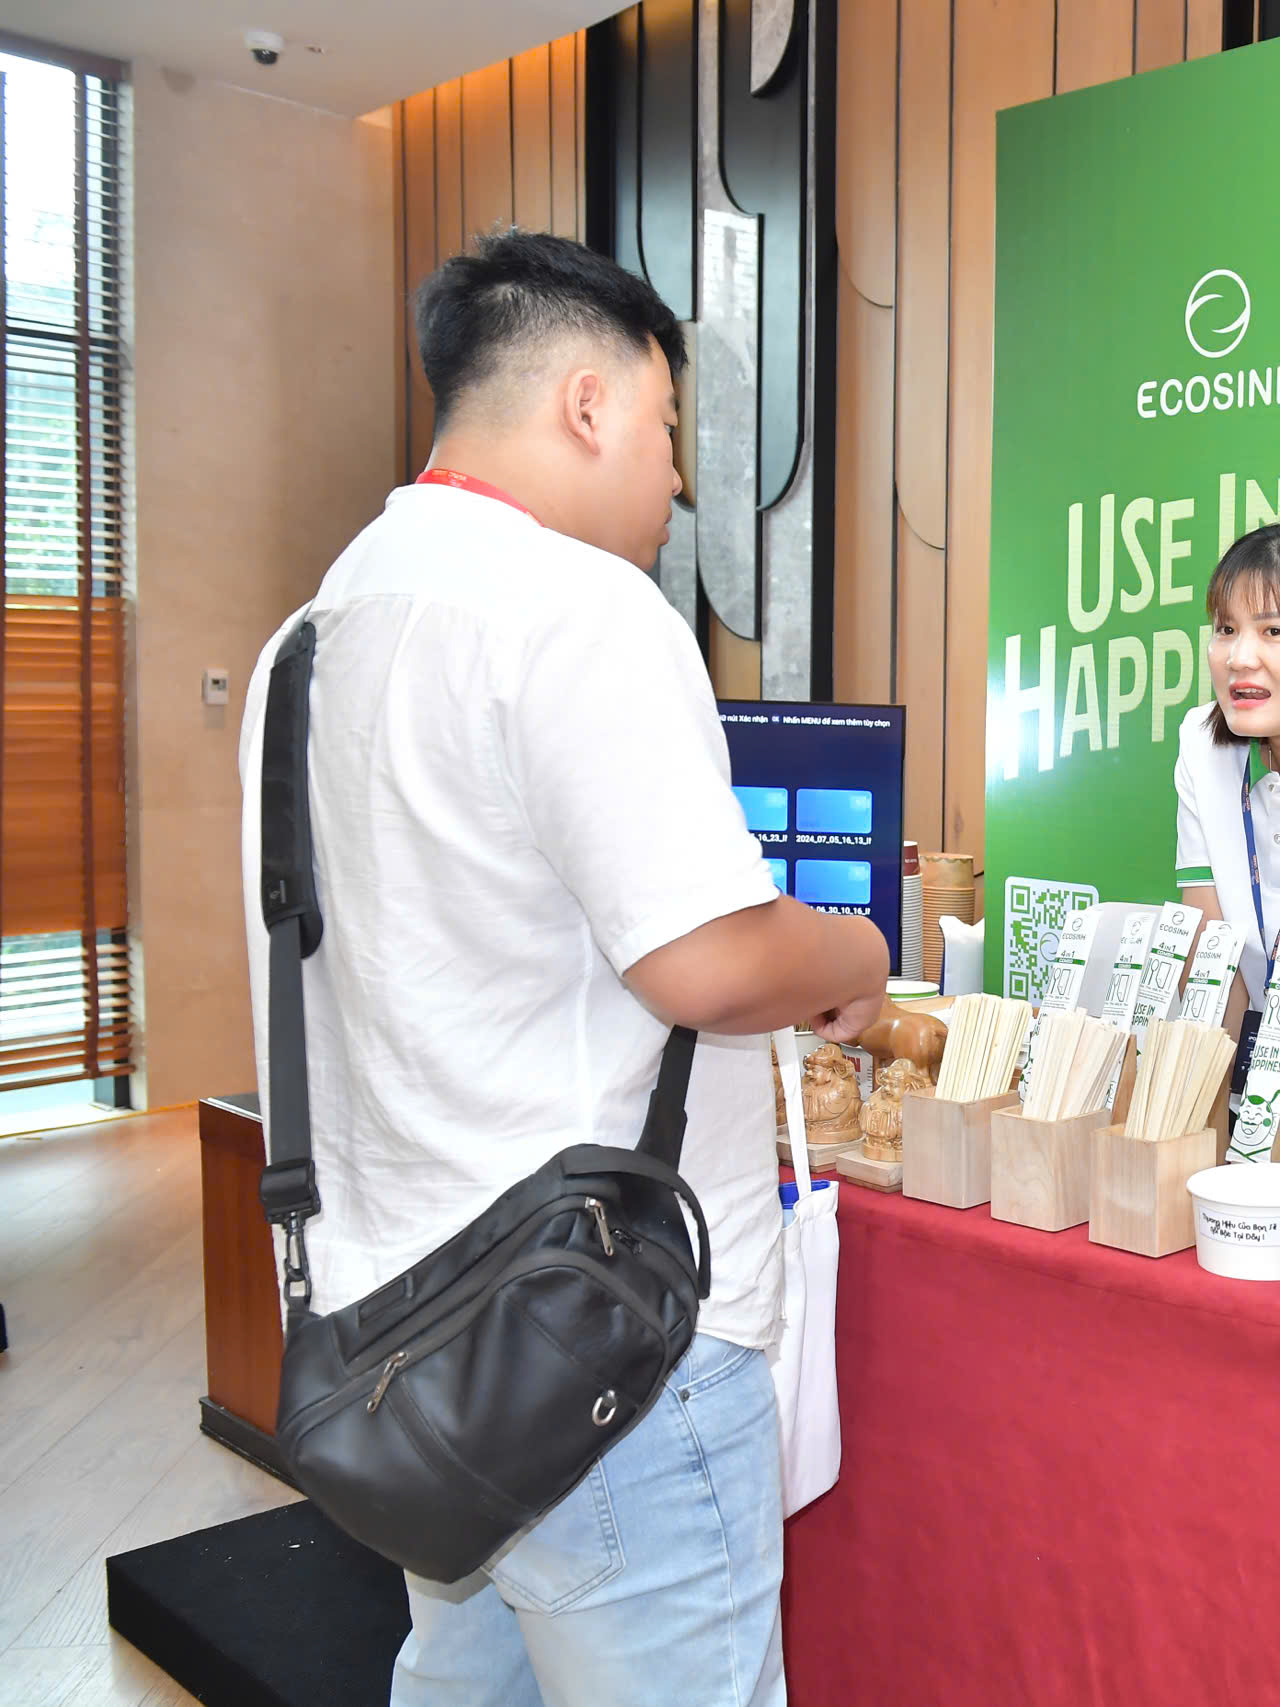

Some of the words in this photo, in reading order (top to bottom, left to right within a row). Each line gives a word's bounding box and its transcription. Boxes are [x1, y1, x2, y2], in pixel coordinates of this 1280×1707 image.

[1067, 493, 1195, 633] USE
[801, 717, 822, 725] MENU
[1160, 923, 1189, 936] ECOSINH
[1196, 951, 1222, 959] ECOSINH
[1254, 1044, 1269, 1059] USE
[1269, 1046, 1280, 1059] IN
